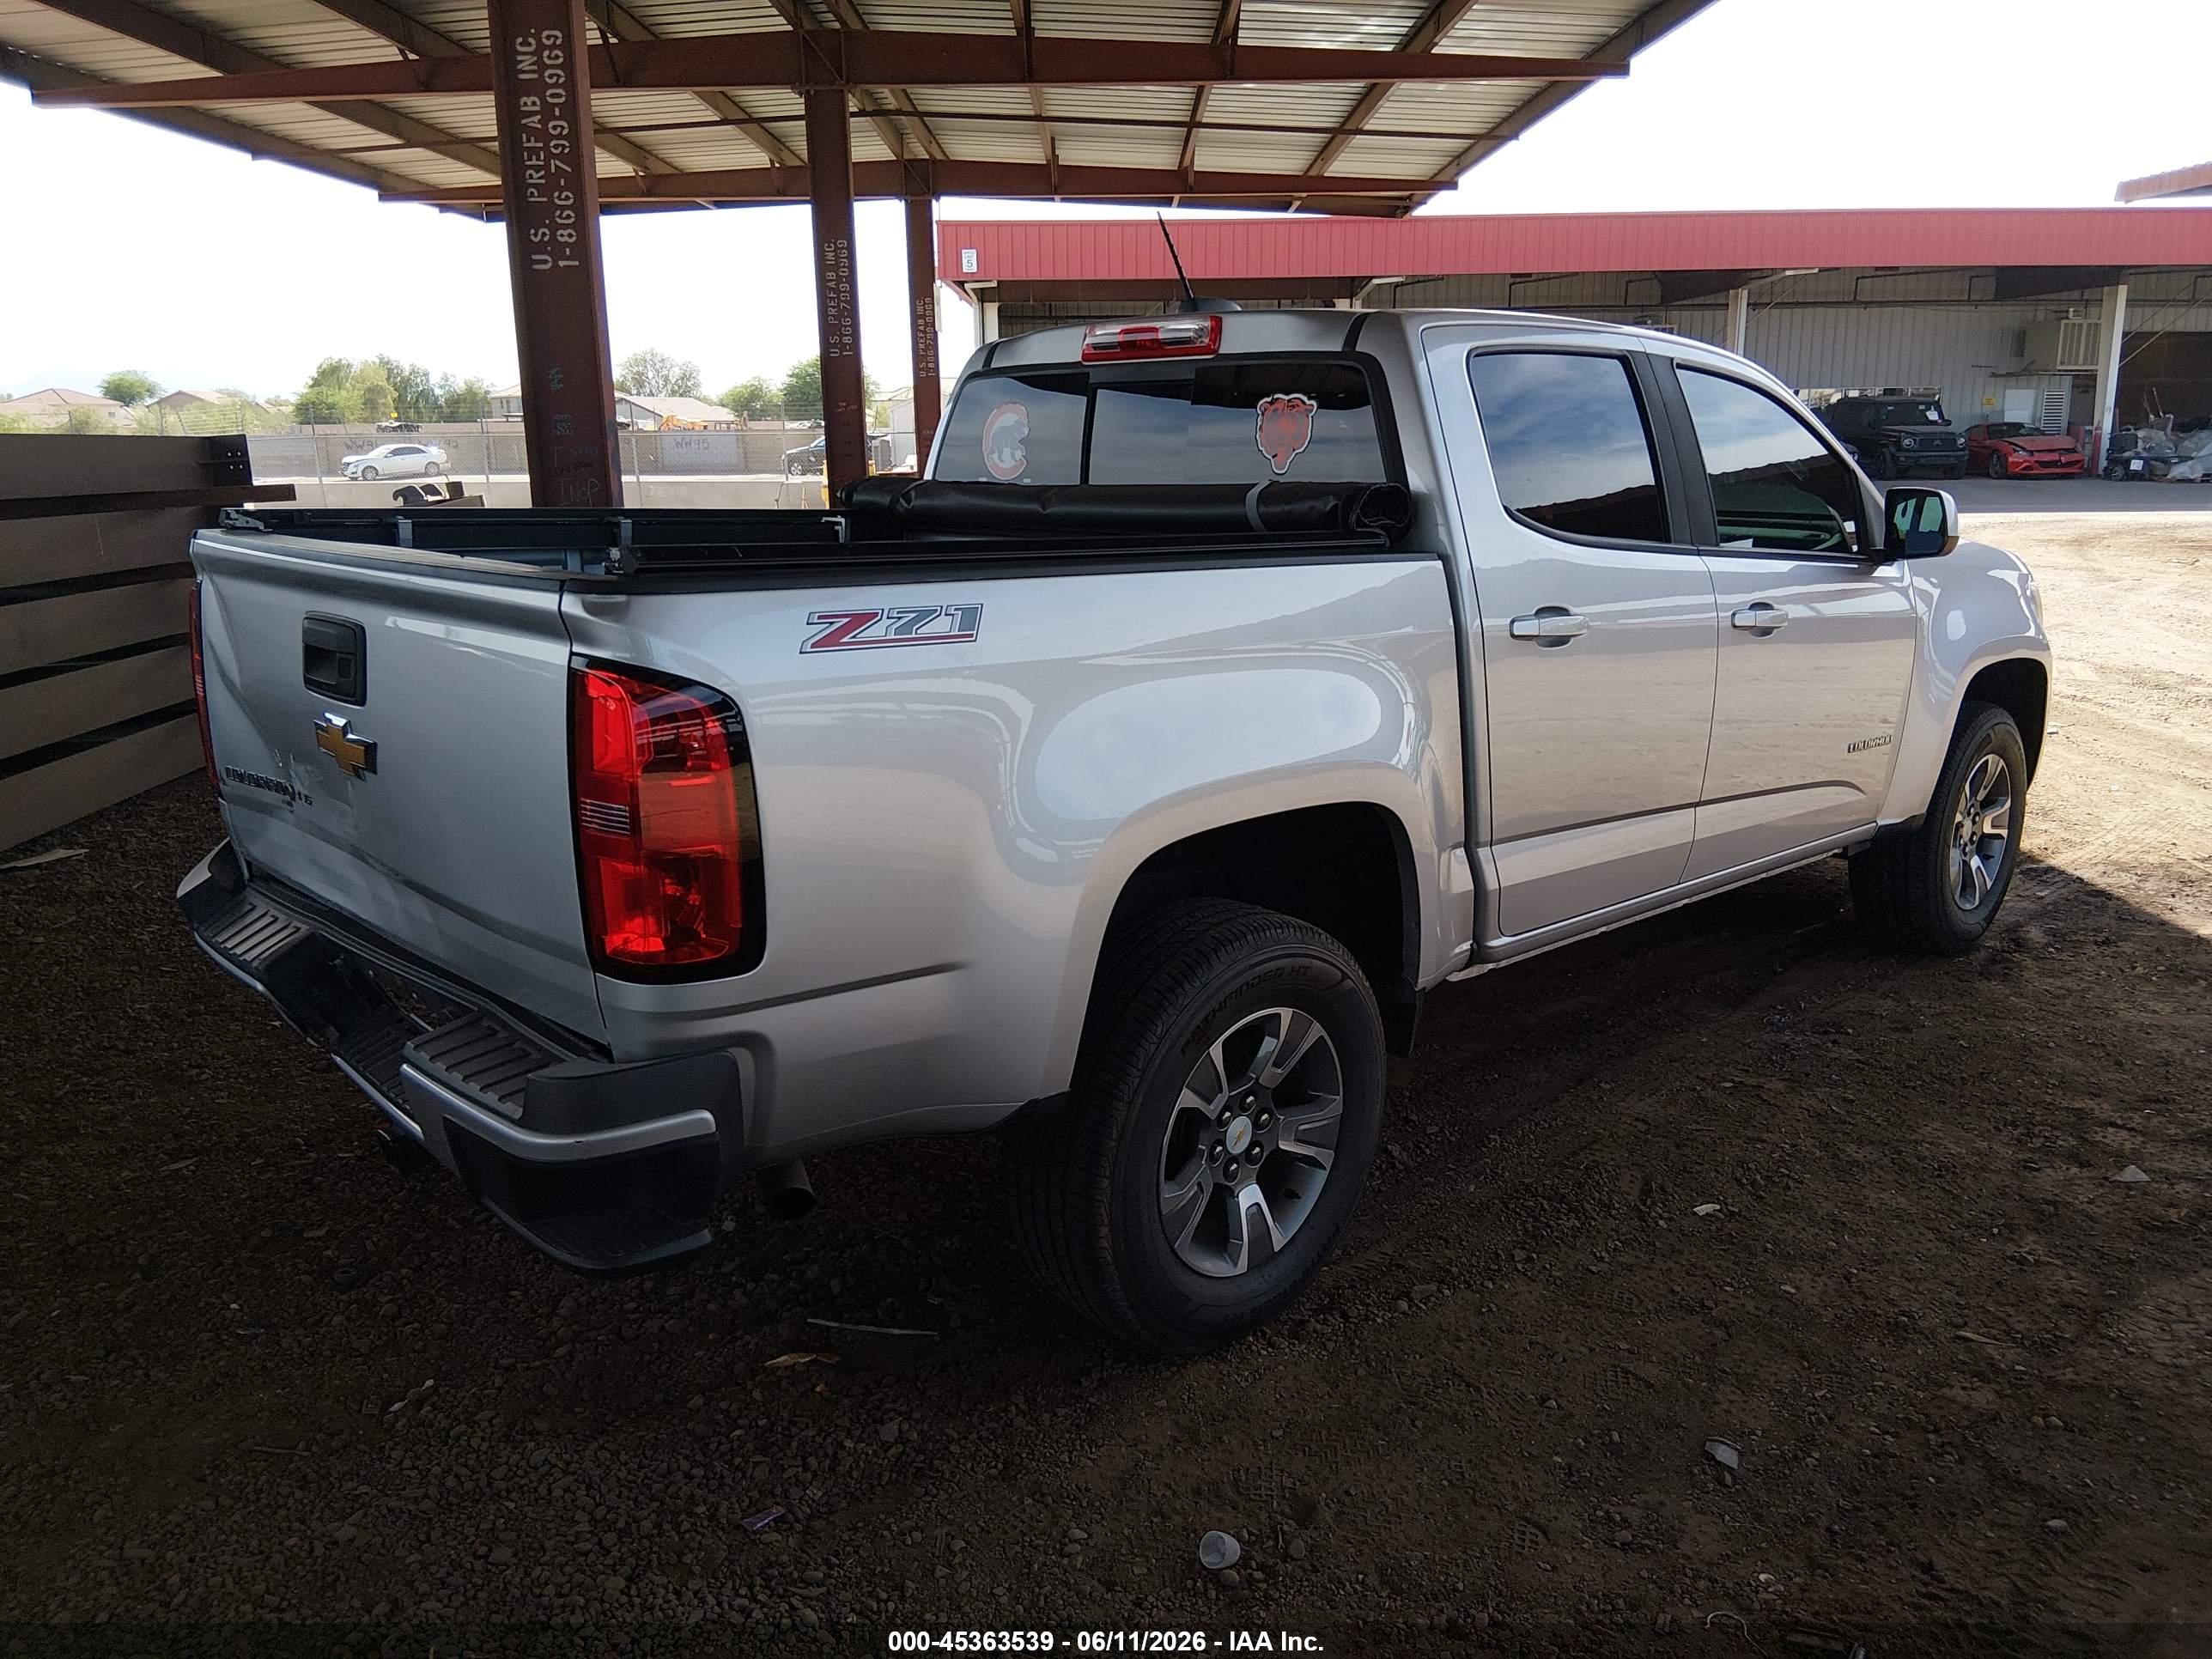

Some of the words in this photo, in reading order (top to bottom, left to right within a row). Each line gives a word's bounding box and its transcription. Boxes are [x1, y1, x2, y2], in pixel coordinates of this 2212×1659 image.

[515, 27, 539, 80] INC.
[520, 95, 547, 203] PREFAB
[541, 29, 580, 267] 1-866-799-0969
[529, 219, 553, 270] U.S.
[824, 239, 836, 264] INC.
[967, 259, 974, 268] 5
[826, 271, 839, 324] PREFAB
[836, 240, 854, 356] 1-866-799-0969
[830, 331, 841, 357] U.S.
[799, 603, 984, 654] Z71
